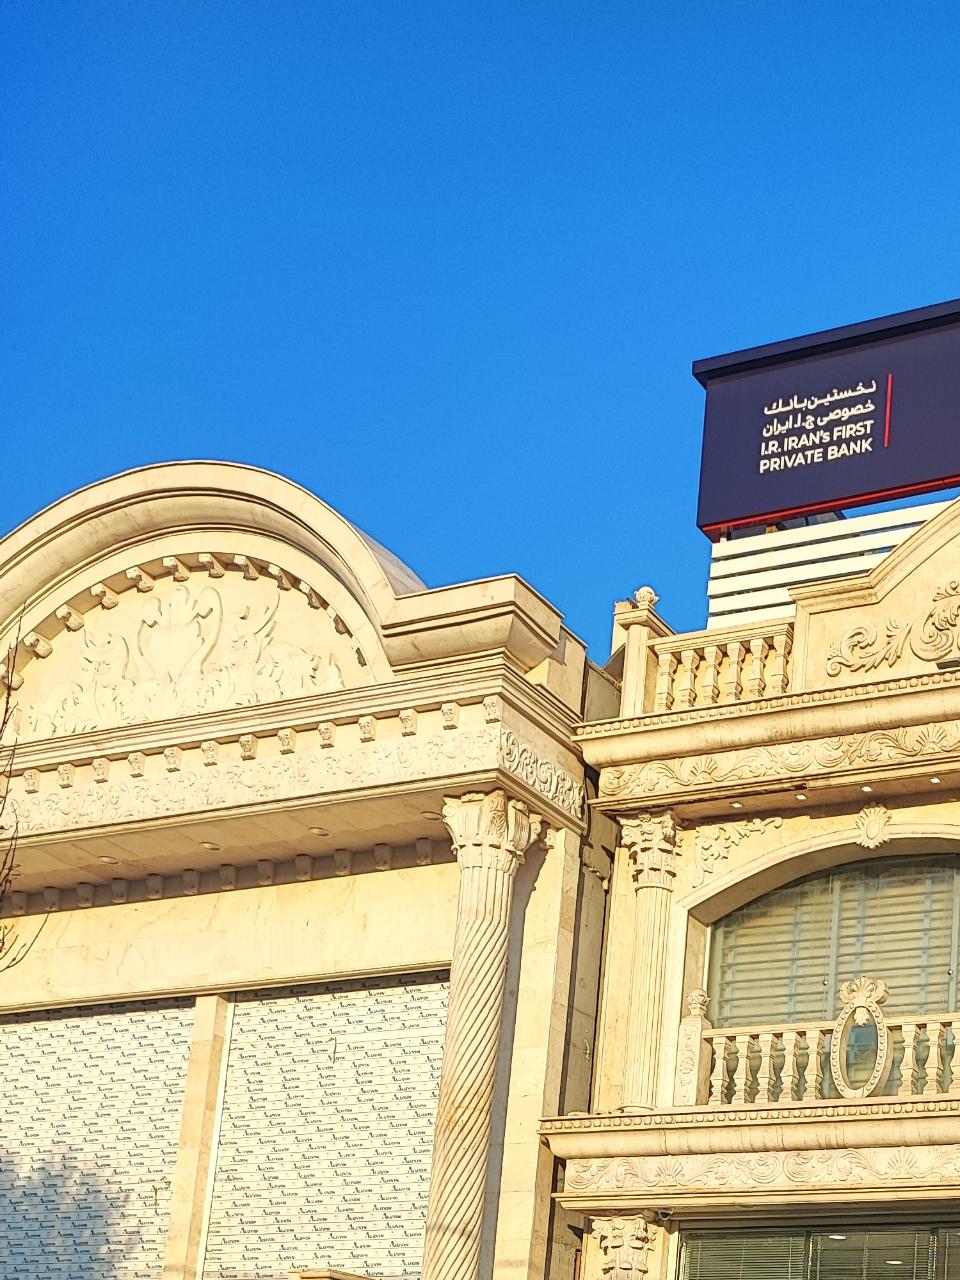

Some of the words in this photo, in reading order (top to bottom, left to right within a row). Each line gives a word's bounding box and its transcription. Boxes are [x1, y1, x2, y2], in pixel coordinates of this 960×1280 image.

[759, 448, 824, 474] PRIVATE
[827, 437, 873, 461] BANK
[761, 441, 782, 456] I.R.
[832, 419, 875, 441] FIRST
